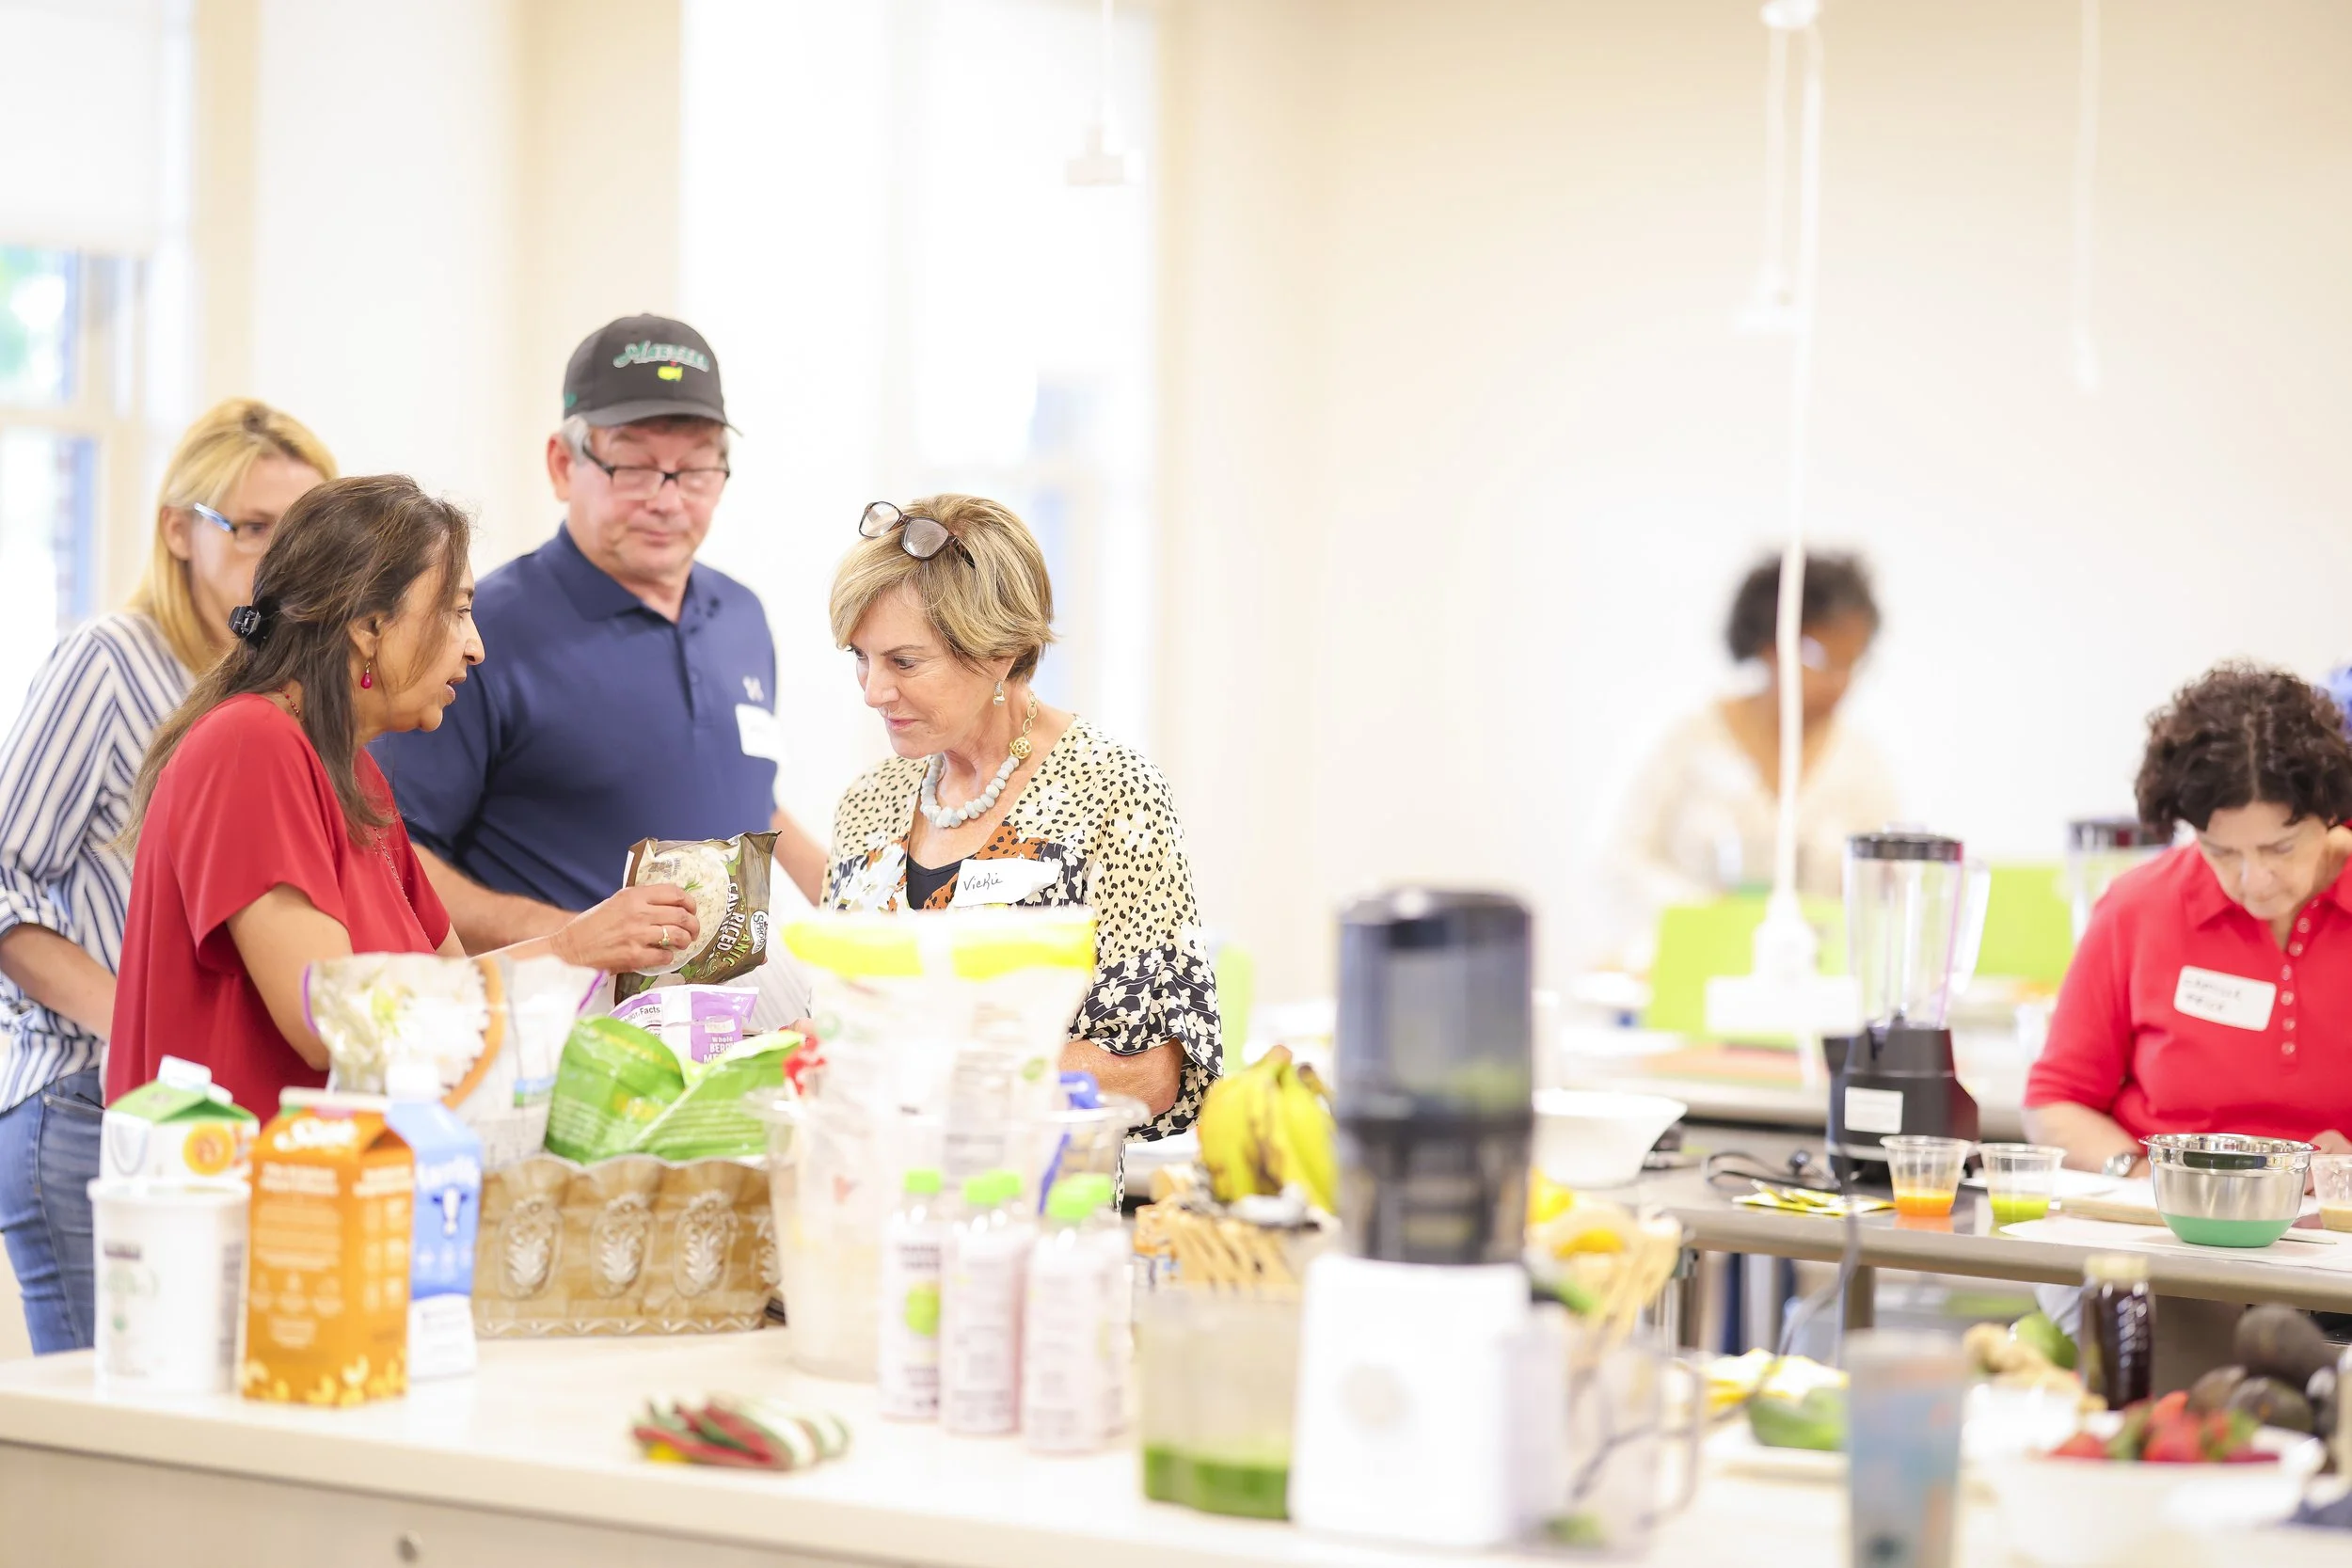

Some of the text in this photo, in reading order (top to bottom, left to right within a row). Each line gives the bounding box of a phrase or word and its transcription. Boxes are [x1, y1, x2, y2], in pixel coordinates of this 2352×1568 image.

[962, 872, 1003, 892] Vickie
[716, 911, 746, 951] RICED
[640, 1005, 660, 1015] Facts
[708, 1042, 736, 1053] BERR
